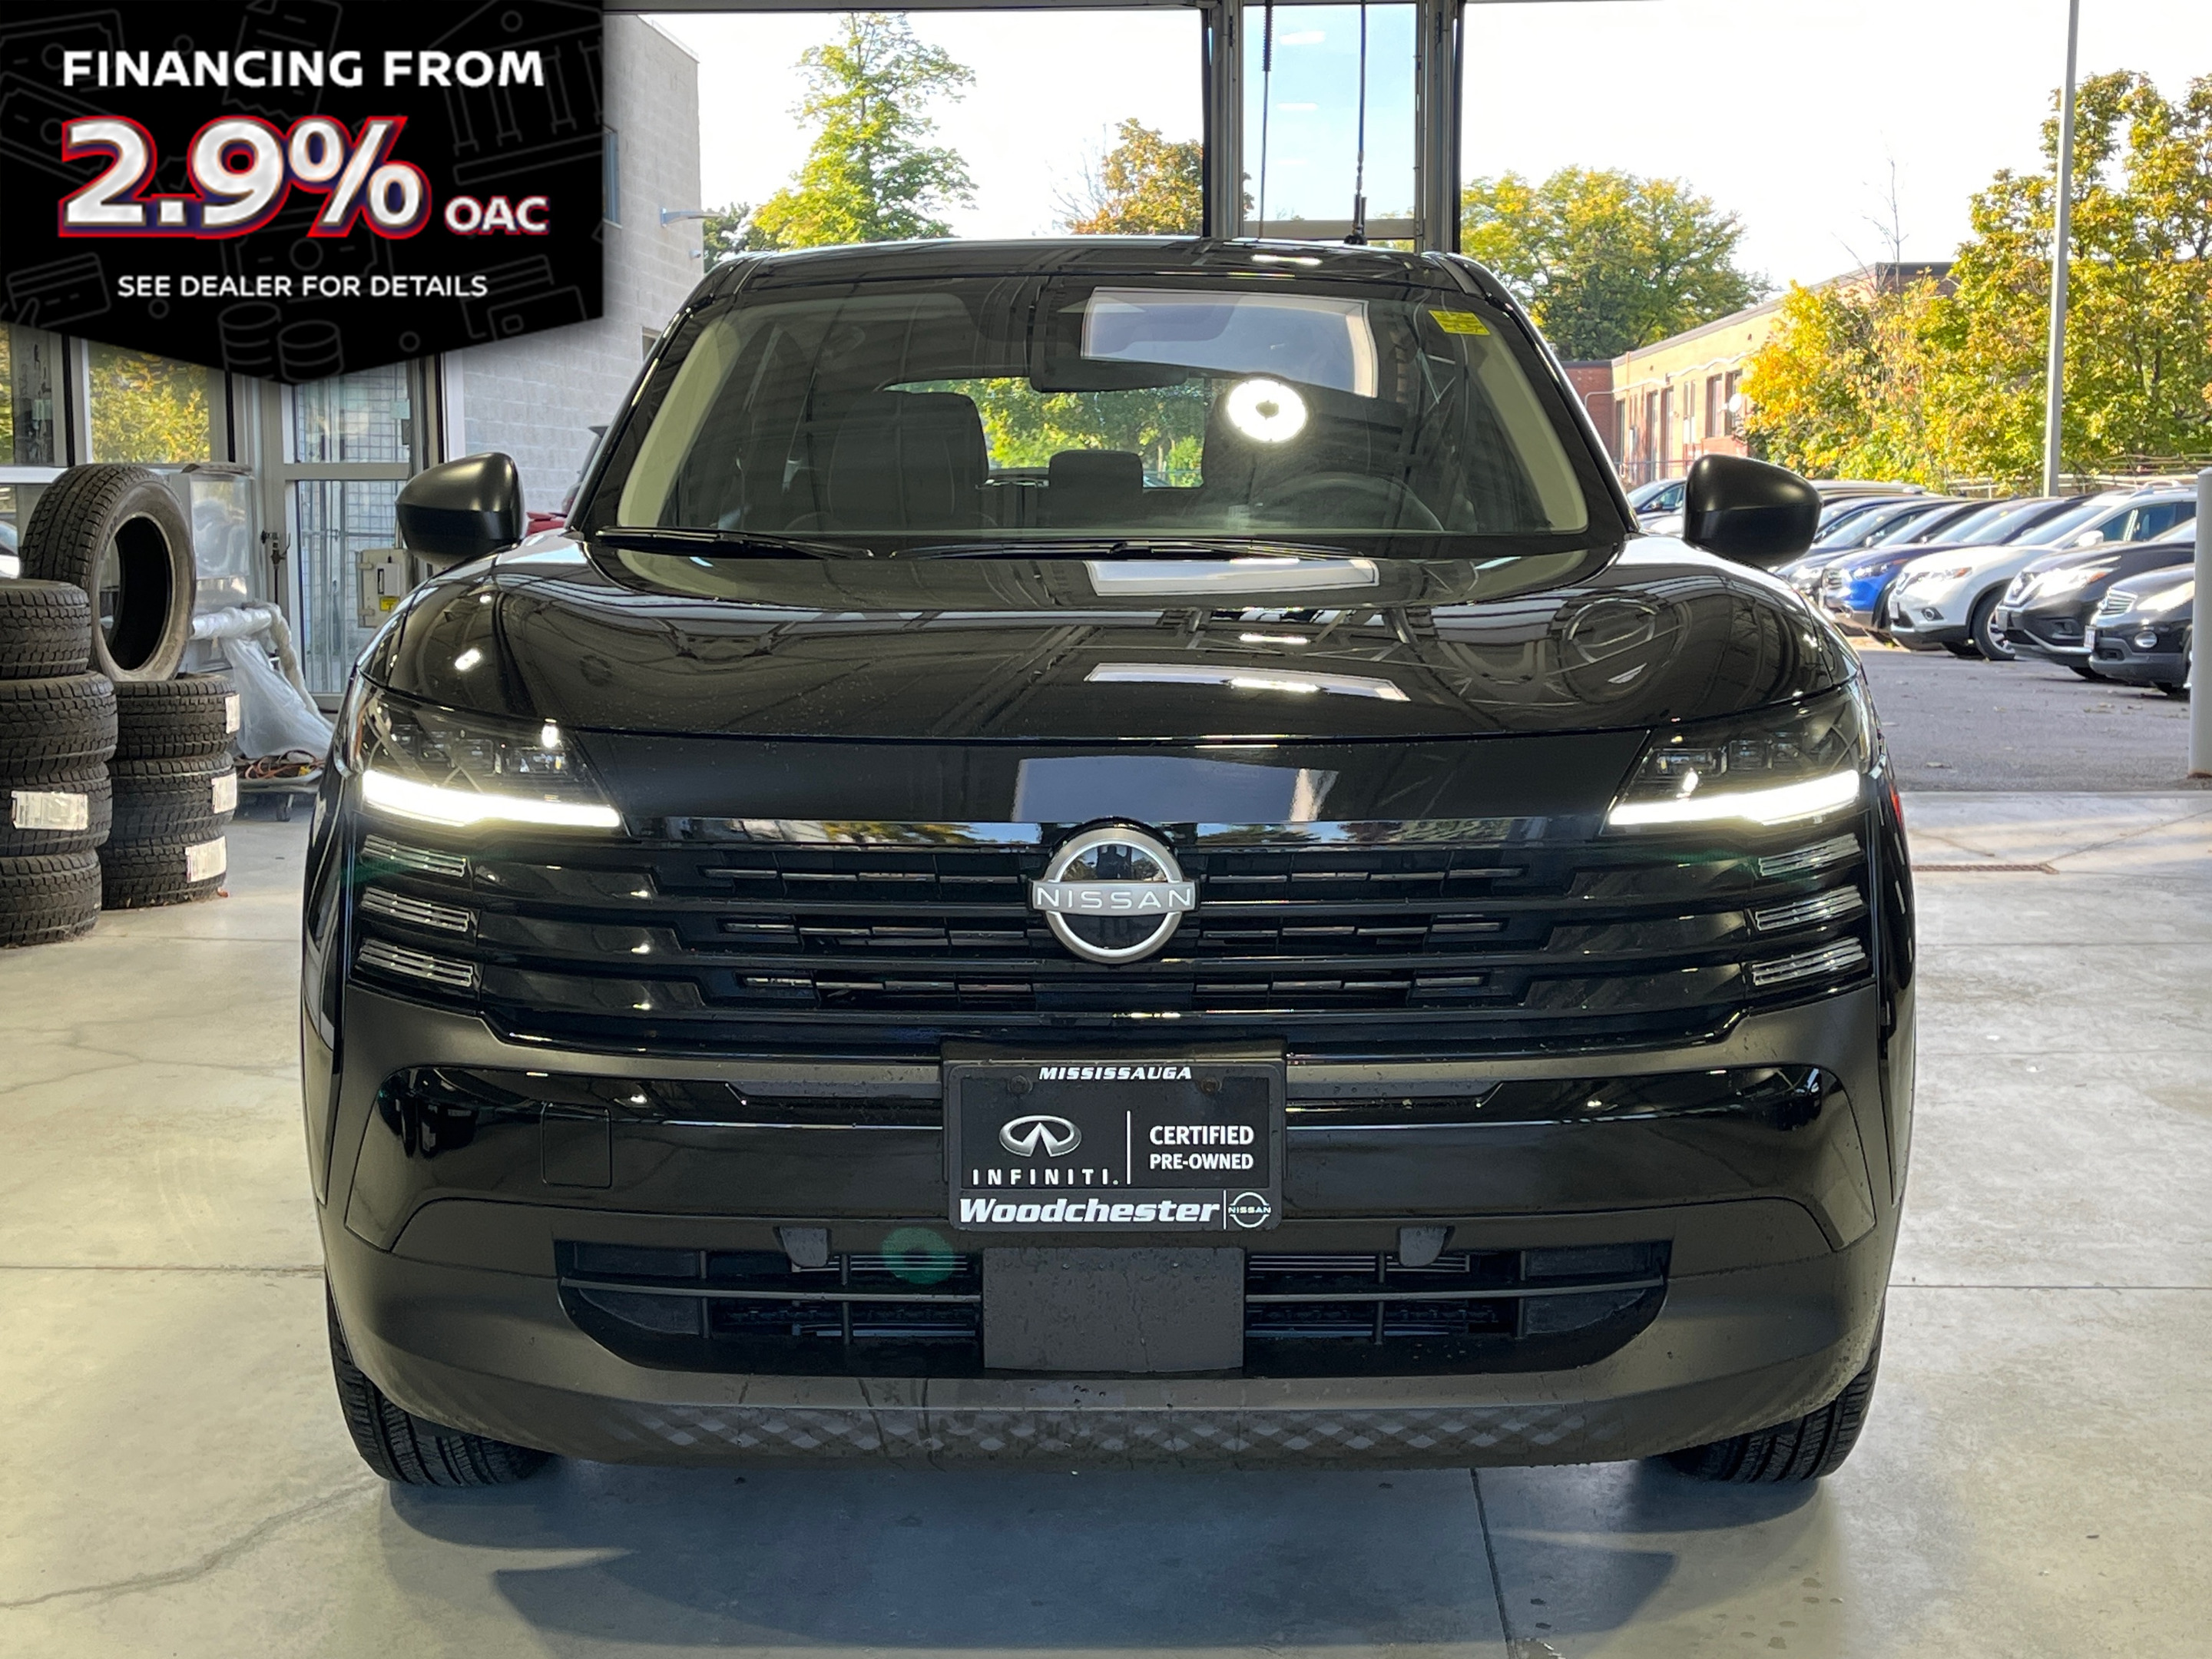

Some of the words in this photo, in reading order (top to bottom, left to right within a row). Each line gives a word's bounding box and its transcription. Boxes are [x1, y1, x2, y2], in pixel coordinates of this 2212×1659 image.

[1037, 886, 1190, 909] NISSAN
[1038, 1066, 1192, 1081] MISSISSAUGA
[1149, 1124, 1254, 1146] CERTIFIED
[1149, 1153, 1254, 1170] PRE-OWNED
[959, 1198, 1220, 1223] Woodchester
[1227, 1205, 1272, 1214] NISSAN
